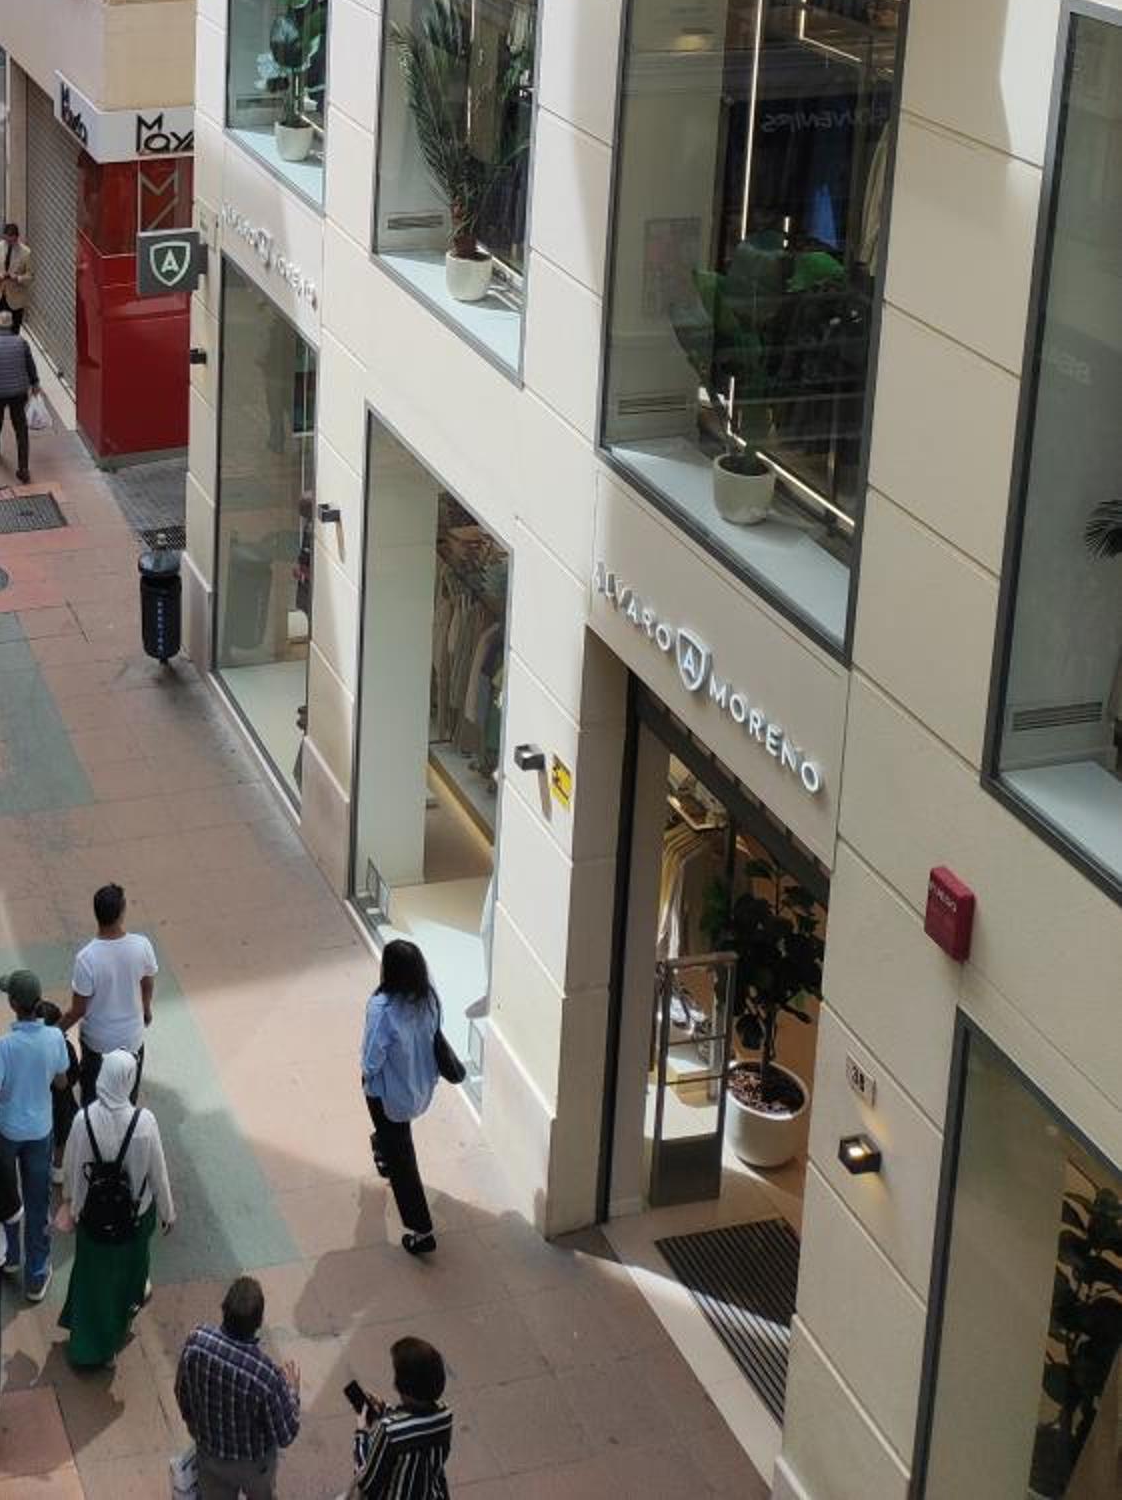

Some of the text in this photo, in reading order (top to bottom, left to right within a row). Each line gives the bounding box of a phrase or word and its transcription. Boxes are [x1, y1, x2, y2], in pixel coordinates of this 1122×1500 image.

[161, 249, 179, 273] A
[593, 562, 672, 652] ALVARO
[709, 674, 821, 793] MORENO
